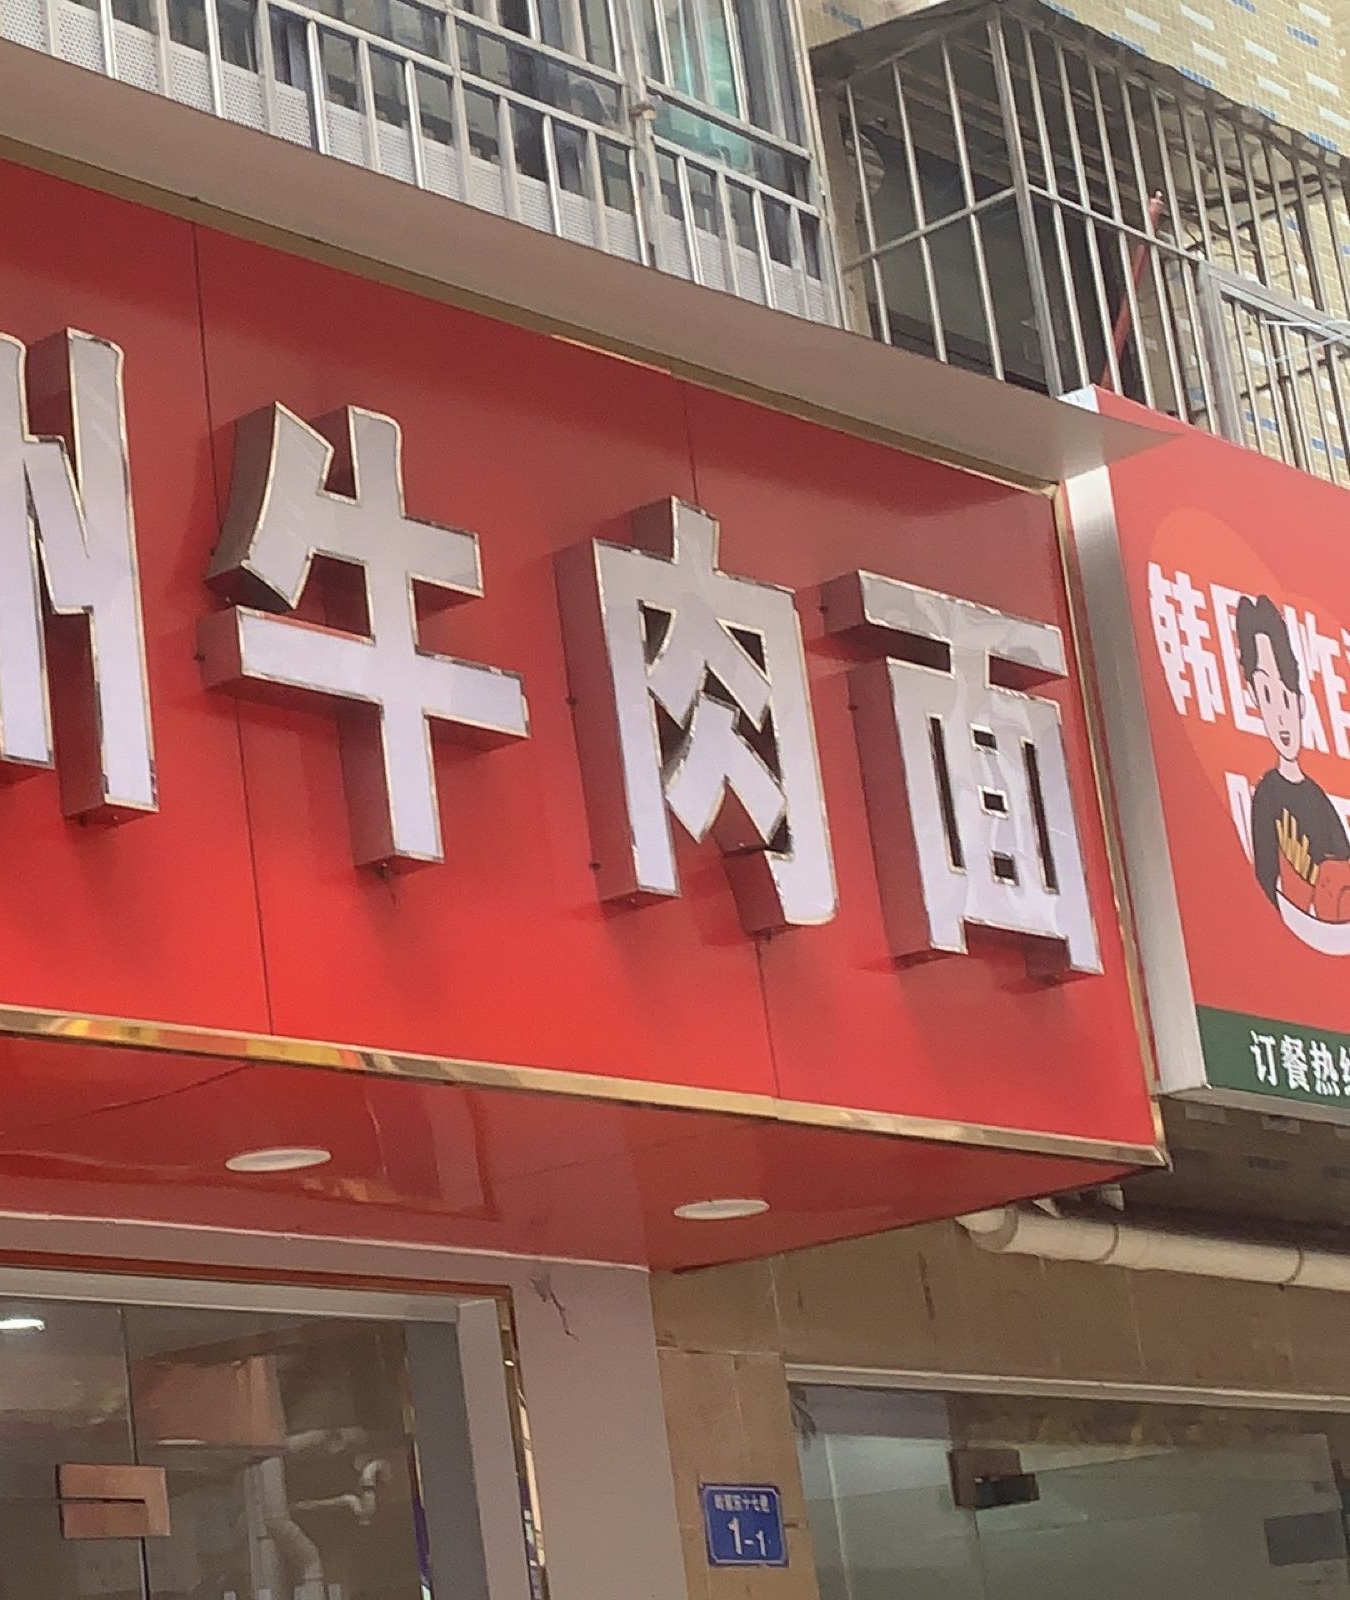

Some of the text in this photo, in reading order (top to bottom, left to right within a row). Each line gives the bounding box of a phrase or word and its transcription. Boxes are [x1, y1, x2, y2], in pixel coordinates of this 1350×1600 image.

[1148, 560, 1350, 762] 韩炸
[1250, 1029, 1350, 1097] 订餐热
[728, 1515, 767, 1558] 1-1
